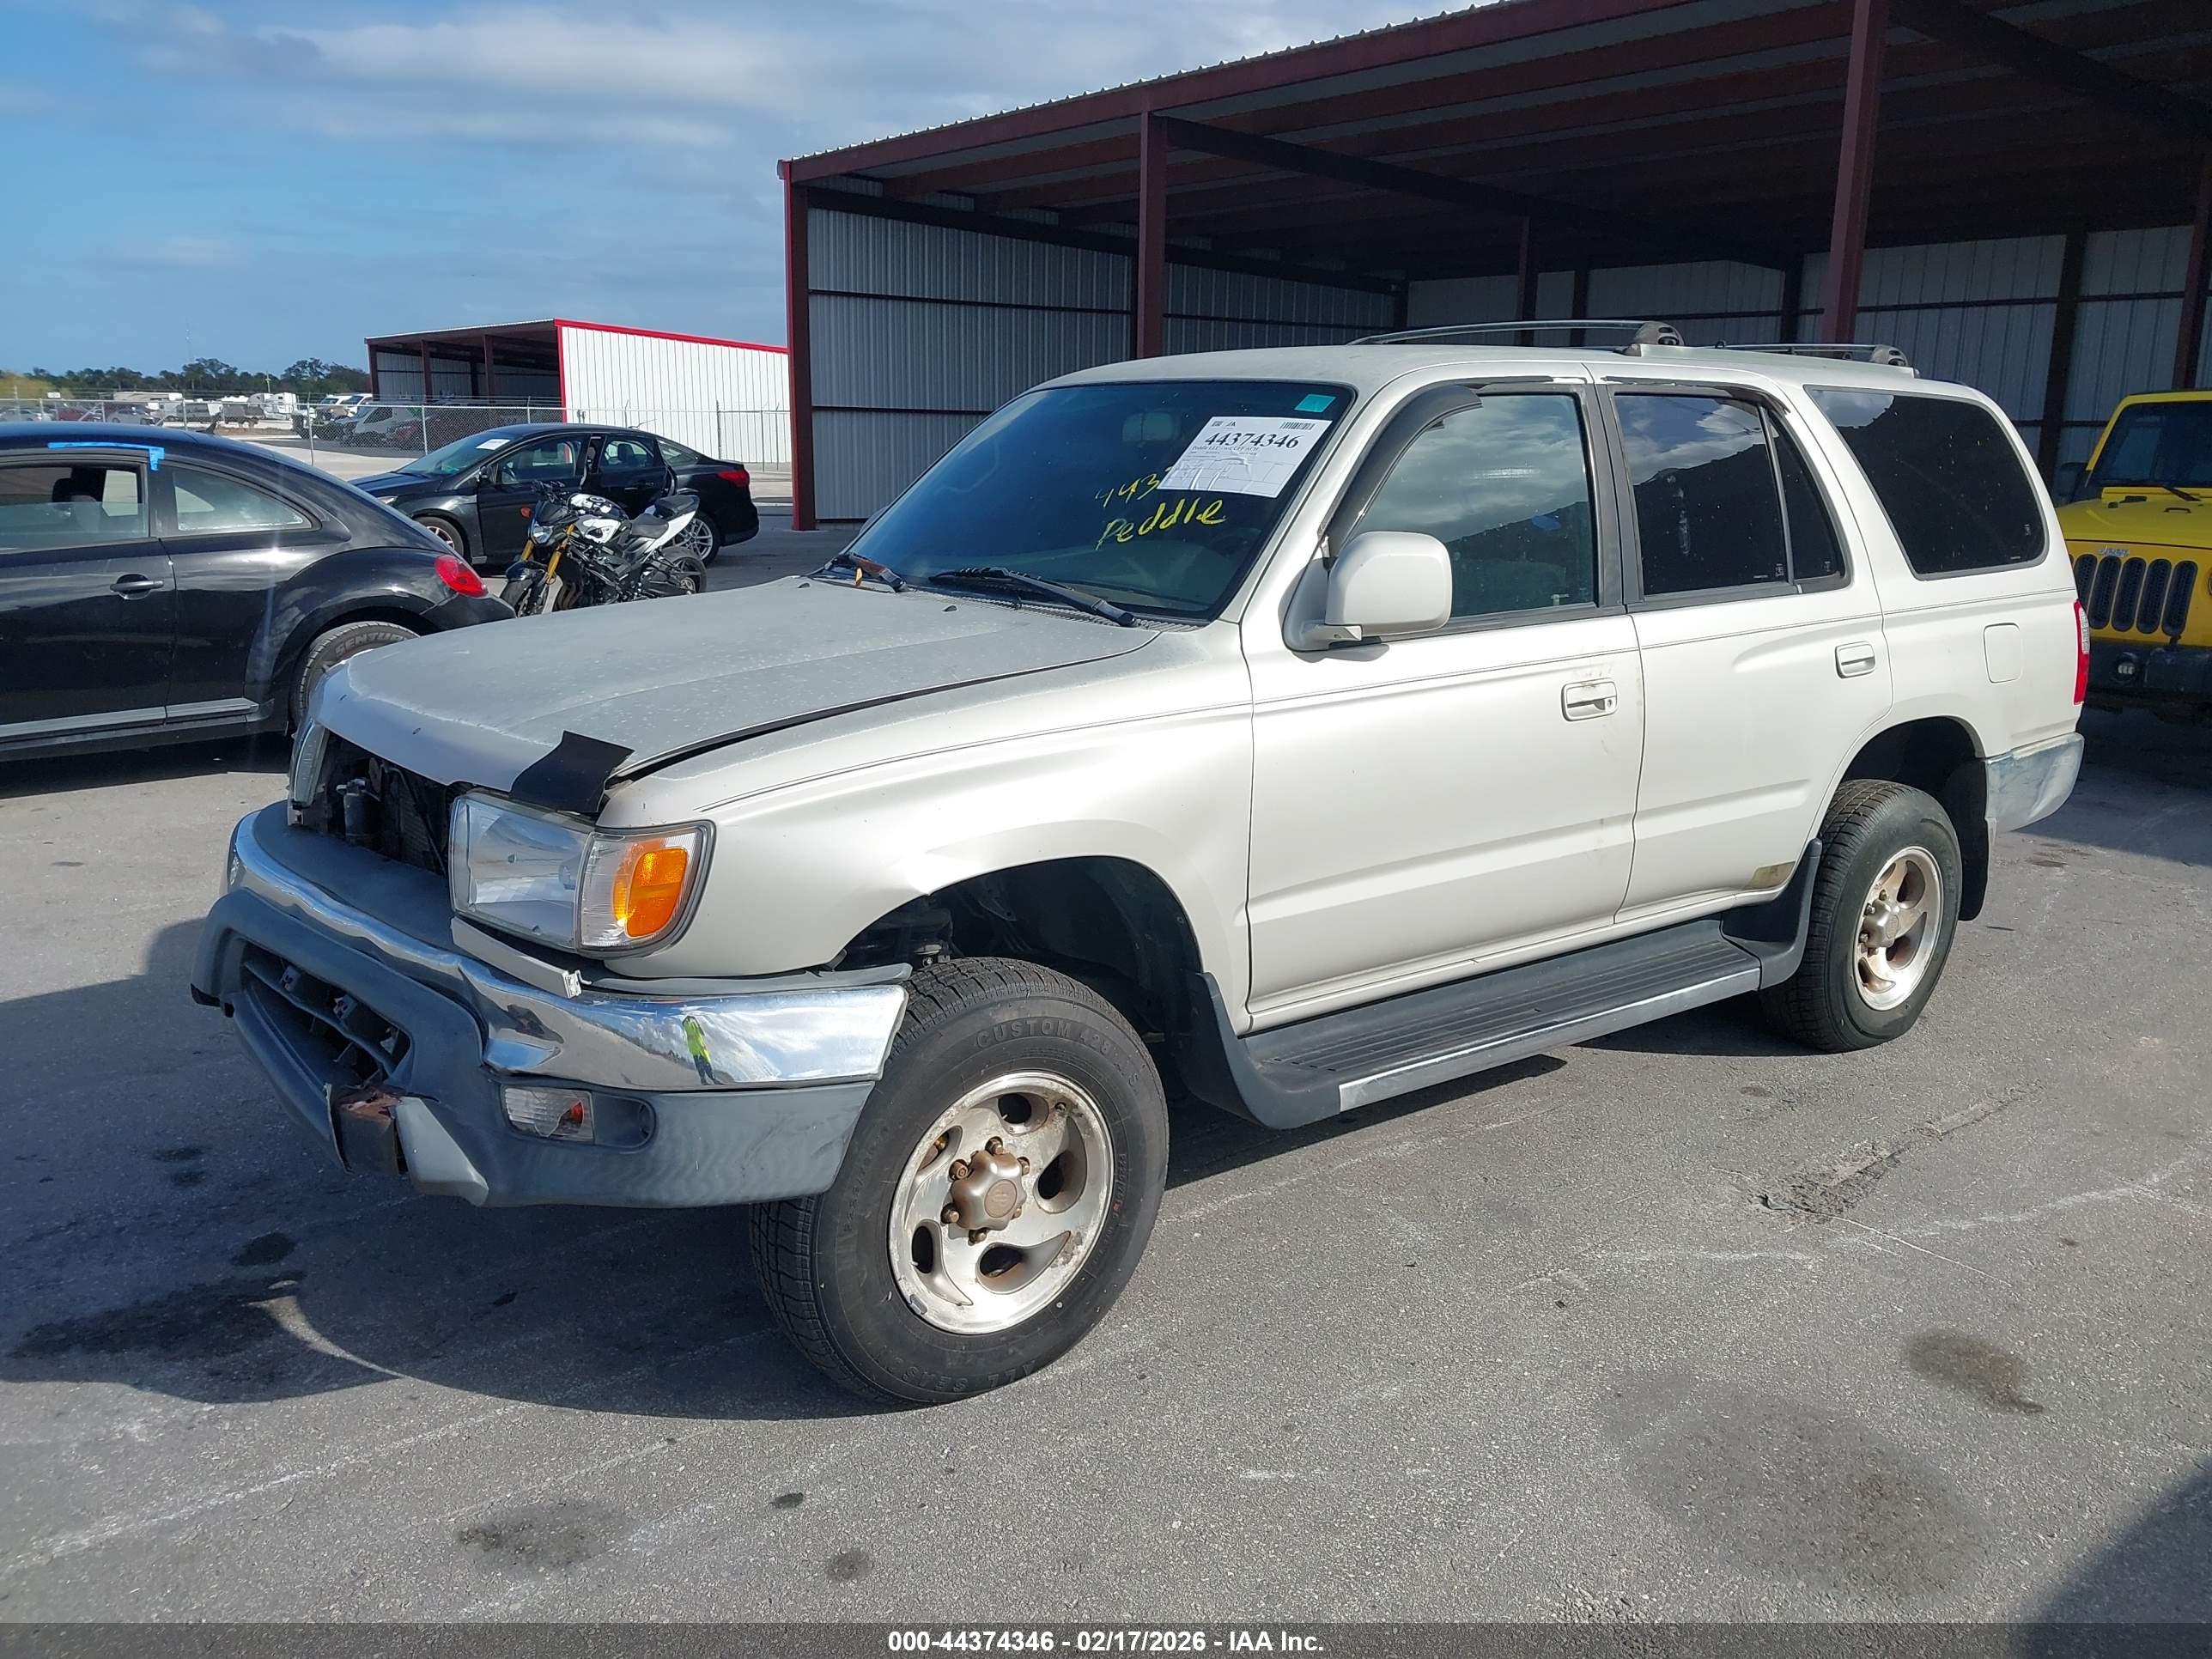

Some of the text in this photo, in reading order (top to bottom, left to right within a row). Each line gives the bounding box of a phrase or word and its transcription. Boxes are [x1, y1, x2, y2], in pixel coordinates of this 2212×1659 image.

[1205, 432, 1305, 449] 44374346
[1095, 495, 1227, 550] Peddle
[335, 631, 408, 659] SENTUR
[975, 1018, 1073, 1048] CUSTOM
